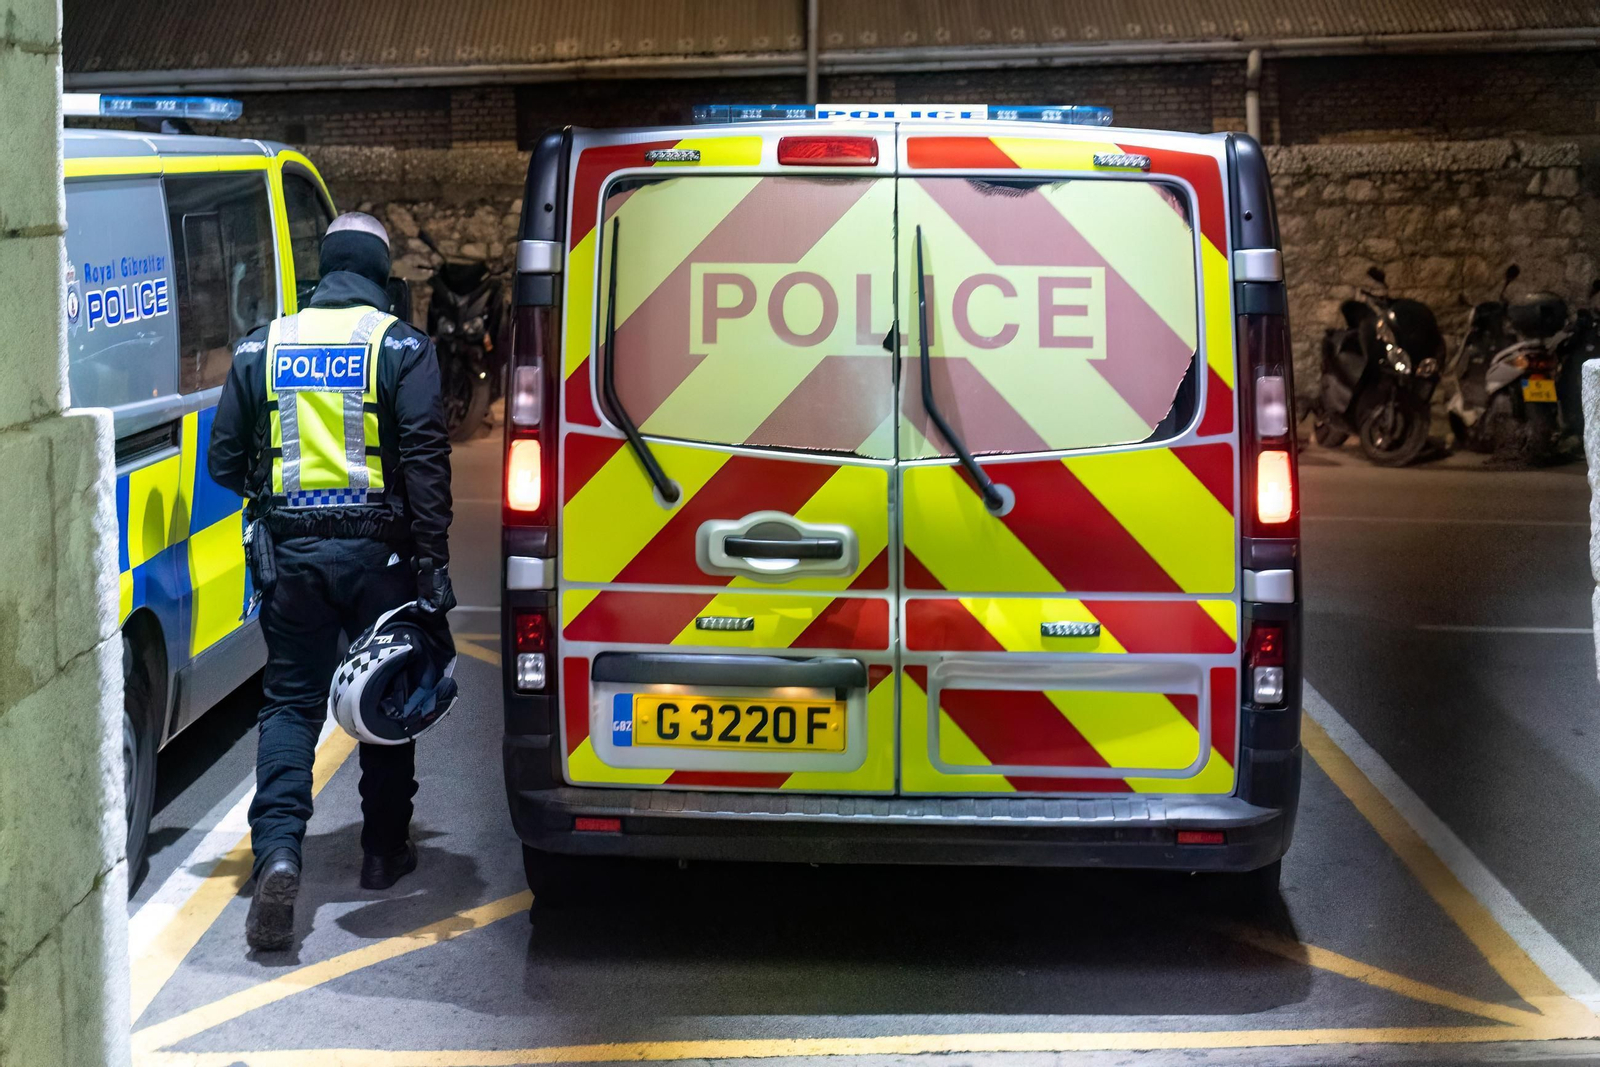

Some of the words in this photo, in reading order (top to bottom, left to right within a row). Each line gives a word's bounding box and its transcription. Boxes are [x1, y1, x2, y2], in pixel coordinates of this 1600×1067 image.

[818, 110, 984, 119] POLICE
[84, 260, 116, 285] Royal
[121, 255, 165, 277] Gibraltar
[86, 277, 169, 332] POLICE
[701, 271, 1094, 350] POLICE
[277, 353, 361, 378] POLICE
[613, 721, 632, 732] GBZ
[656, 703, 680, 740] G
[690, 704, 796, 744] 3220
[806, 707, 831, 744] F
